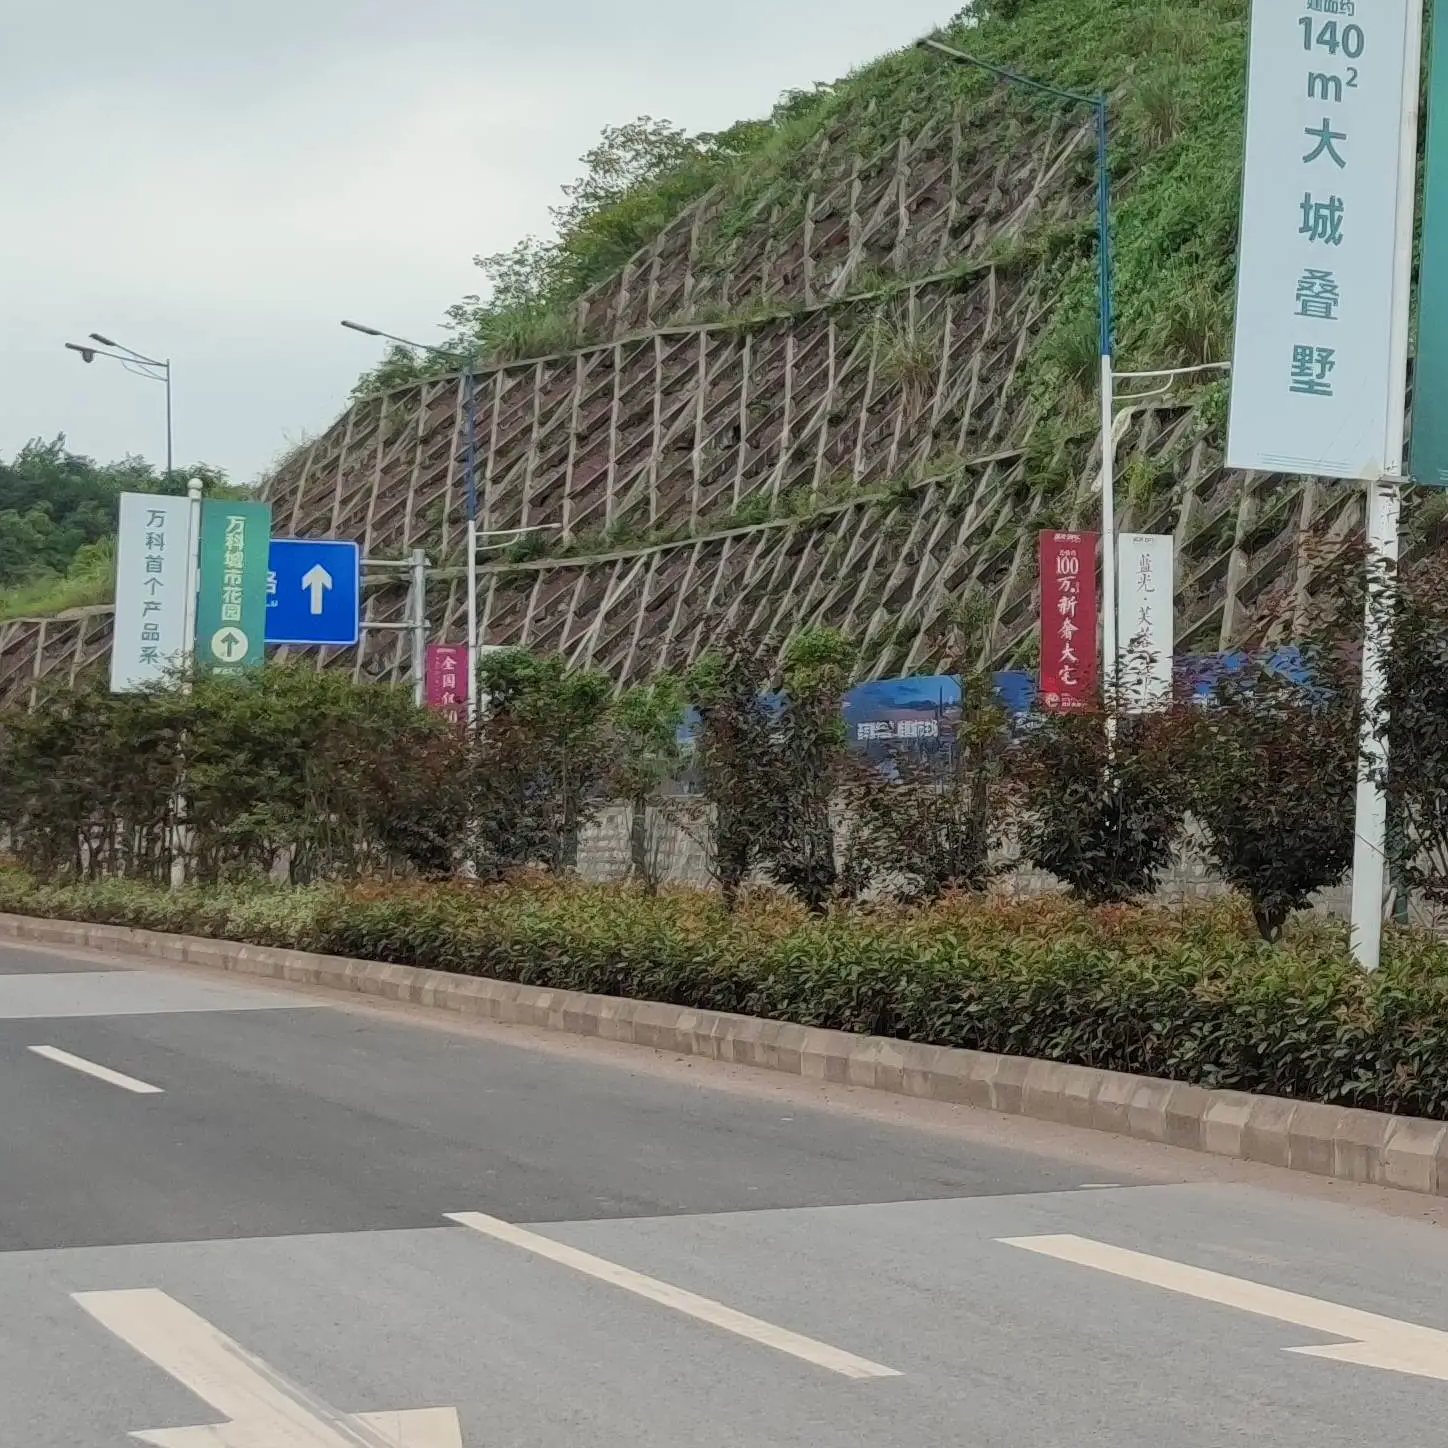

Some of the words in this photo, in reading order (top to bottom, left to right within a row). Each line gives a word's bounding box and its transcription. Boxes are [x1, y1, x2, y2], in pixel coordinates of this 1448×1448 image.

[1299, 16, 1365, 59] 140
[1288, 117, 1347, 397] 大城叠墅
[1056, 557, 1079, 575] 100
